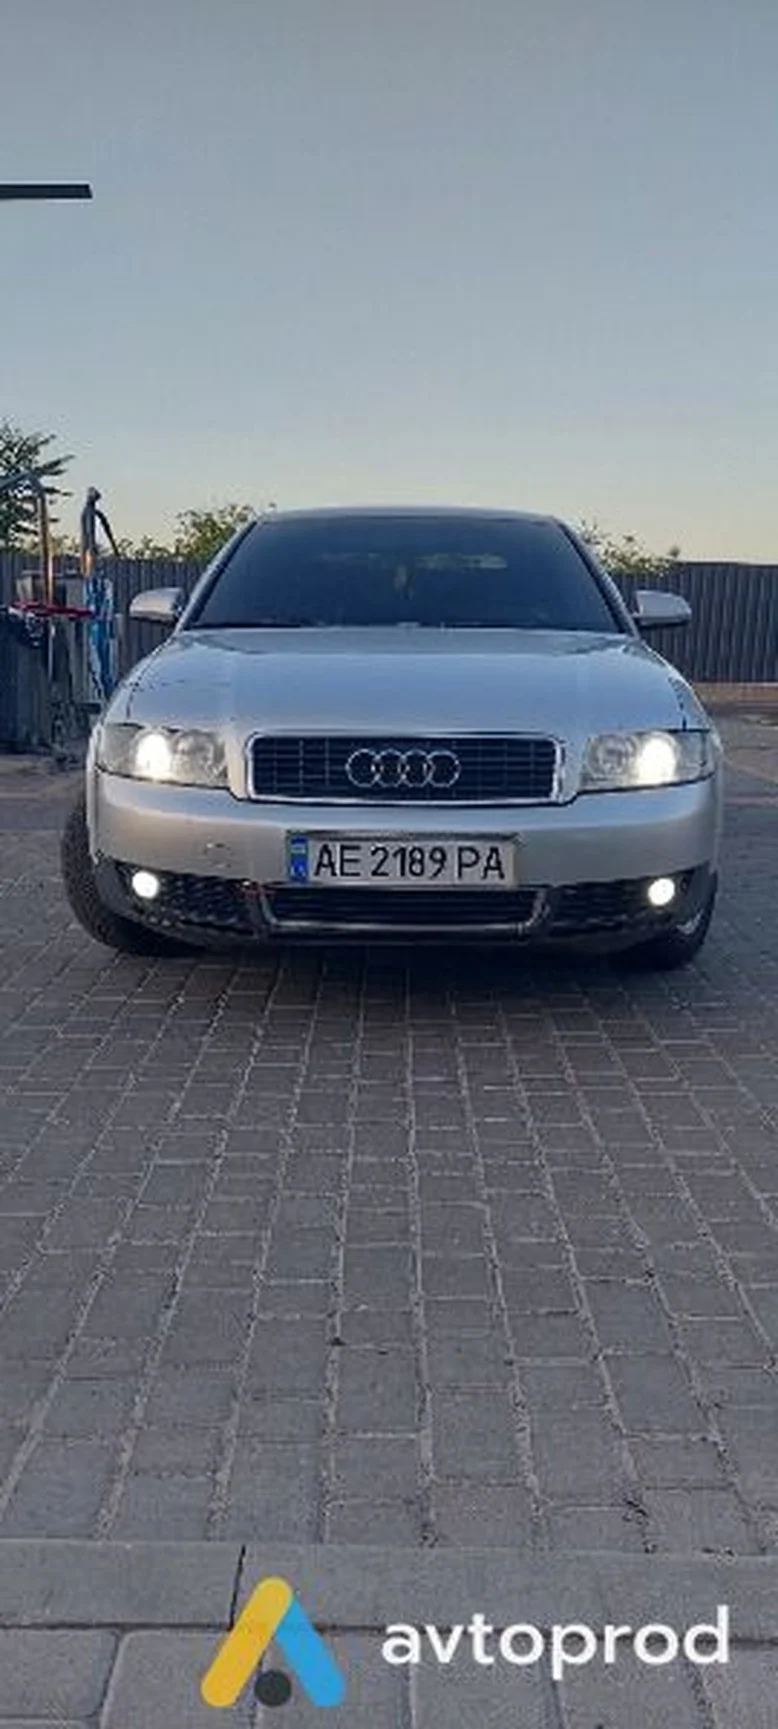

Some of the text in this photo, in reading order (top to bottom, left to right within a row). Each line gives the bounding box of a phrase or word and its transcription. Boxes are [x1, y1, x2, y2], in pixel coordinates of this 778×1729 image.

[314, 844, 361, 877] AE
[370, 846, 447, 879] 2189
[456, 846, 505, 880] PA
